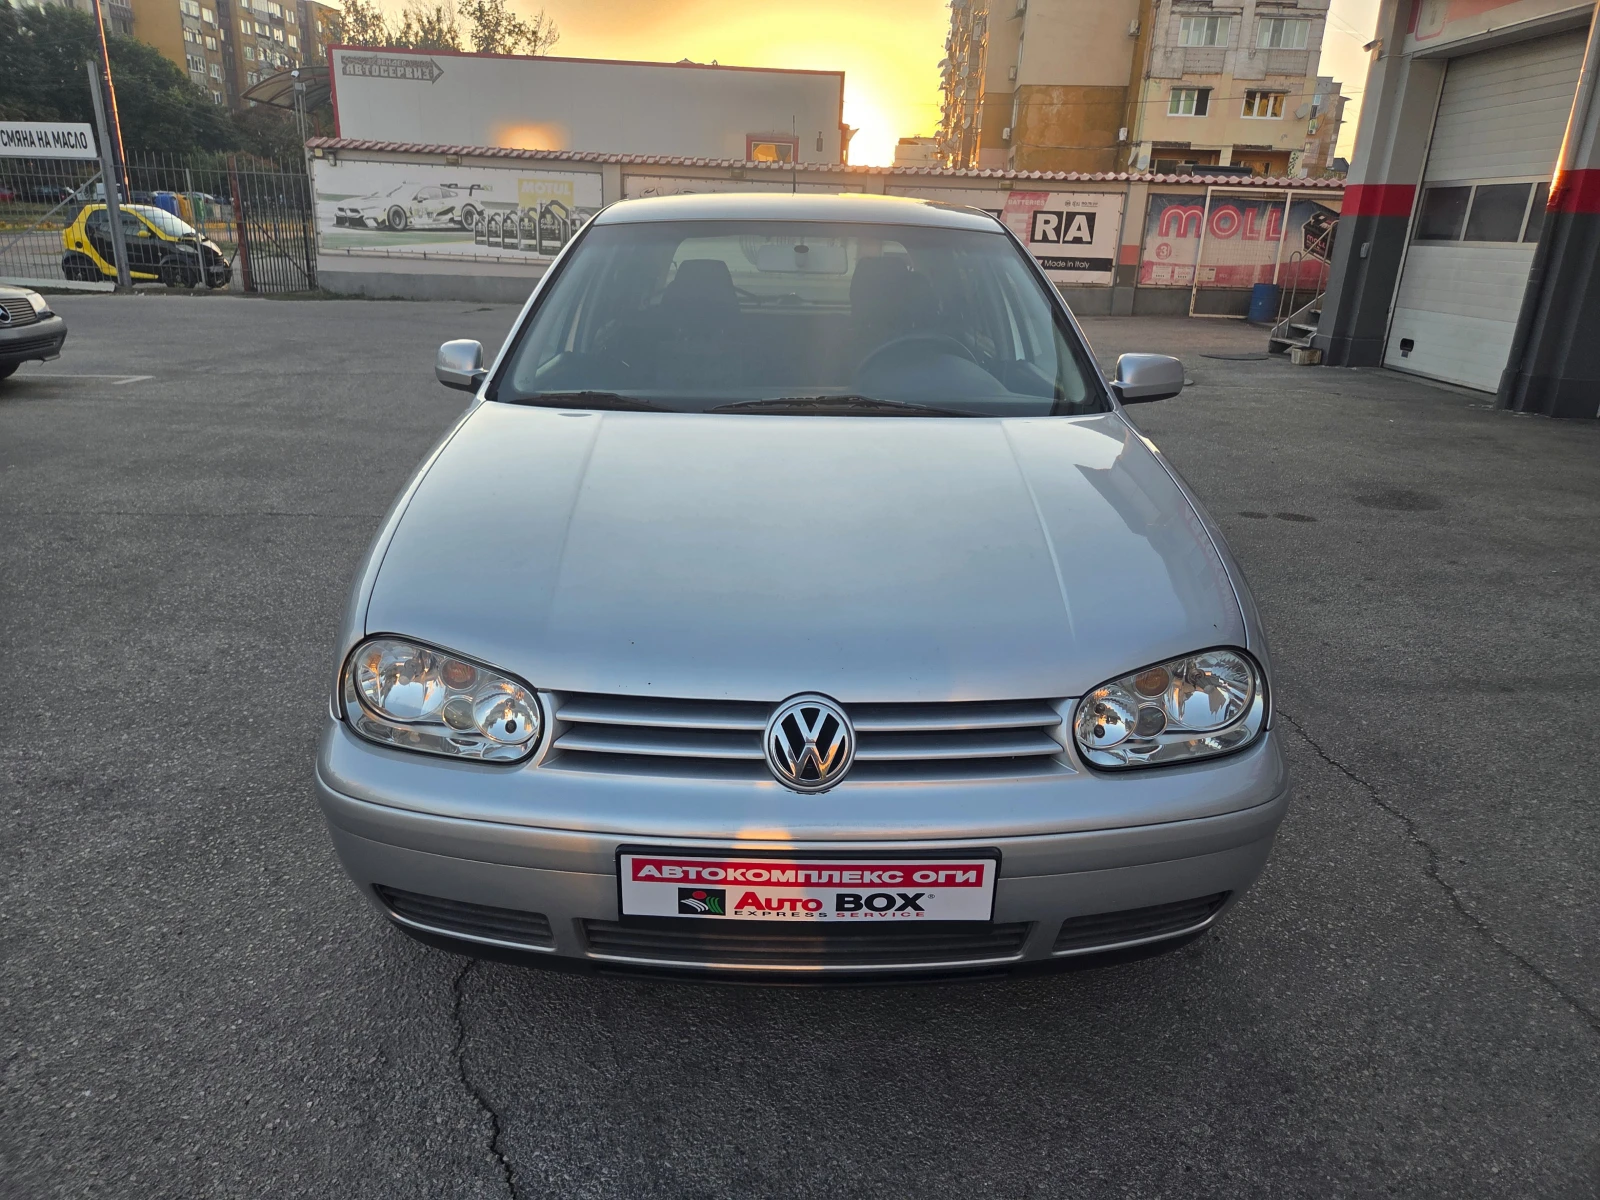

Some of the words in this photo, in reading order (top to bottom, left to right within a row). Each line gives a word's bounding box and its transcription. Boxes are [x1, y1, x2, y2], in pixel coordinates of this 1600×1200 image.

[346, 64, 431, 79] АВТОСЕРВИЗ
[0, 129, 36, 148] СМЯНА
[36, 131, 52, 148] НА
[51, 131, 88, 149] МАСЛО
[521, 181, 571, 195] MOTUL
[1158, 205, 1288, 241] MOLL
[1044, 260, 1066, 268] Made
[1066, 260, 1074, 268] in
[1074, 261, 1090, 269] Italy
[637, 864, 904, 884] АВТОКОМПЛЕКС
[912, 870, 977, 884] ОГИ
[734, 910, 828, 918] EXPRESS
